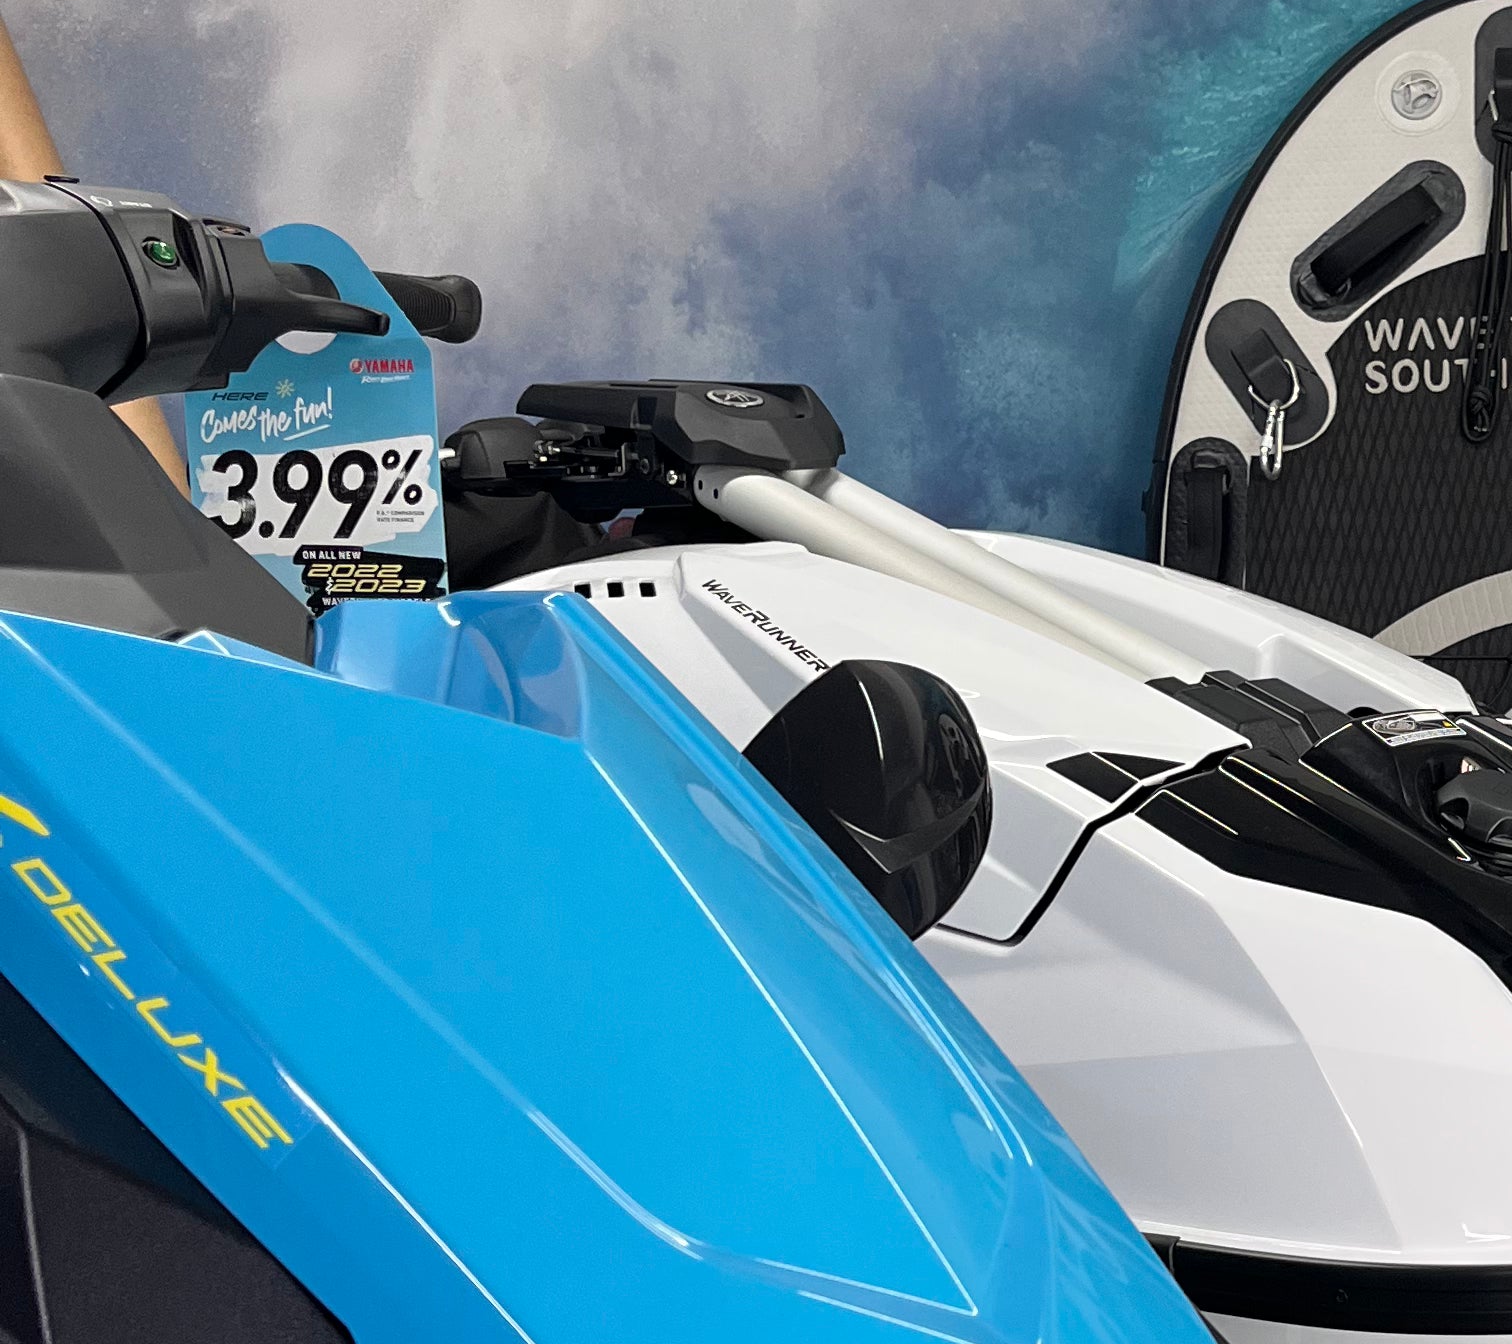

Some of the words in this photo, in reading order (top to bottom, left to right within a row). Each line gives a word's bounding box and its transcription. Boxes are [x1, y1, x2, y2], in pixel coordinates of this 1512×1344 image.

[365, 359, 414, 374] YAMAHA
[211, 391, 269, 402] HERE
[258, 407, 292, 443] the
[292, 386, 333, 431] fun!
[302, 550, 316, 560] ON
[318, 551, 336, 560] ALL
[338, 551, 361, 560] NEW
[307, 563, 403, 578] 2022
[331, 578, 427, 594] 2023
[10, 857, 294, 1149] DELUXE
